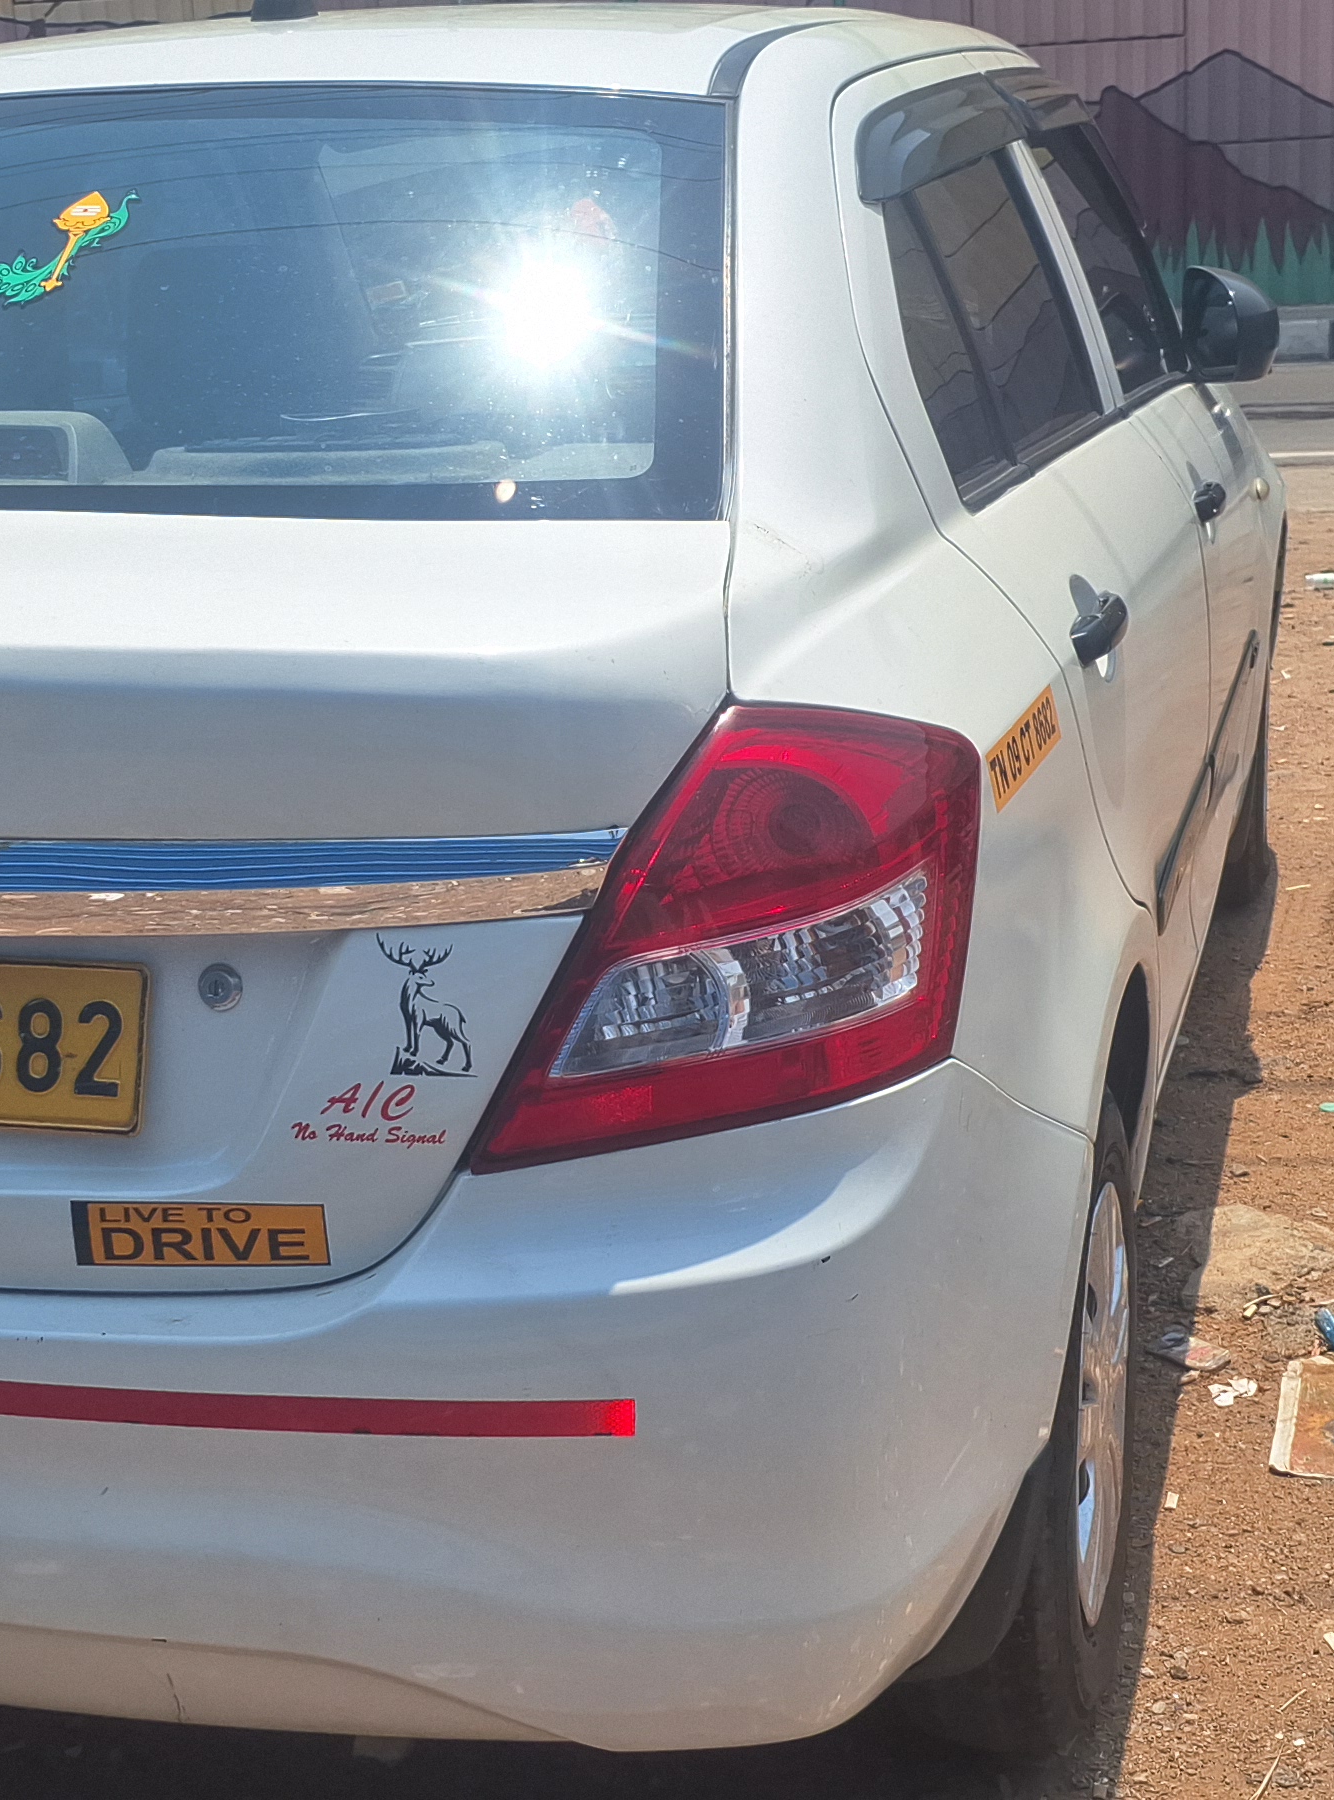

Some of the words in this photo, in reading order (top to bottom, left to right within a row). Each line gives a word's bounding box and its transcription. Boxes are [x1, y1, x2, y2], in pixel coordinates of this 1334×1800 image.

[990, 750, 1010, 799] TN
[1007, 735, 1022, 782] 09
[1020, 719, 1036, 766] CT
[1032, 696, 1057, 751] 8682
[320, 1080, 416, 1121] A/C
[291, 1121, 318, 1141] No
[325, 1123, 379, 1143] Hand
[385, 1125, 447, 1149] Signal
[99, 1206, 185, 1223] LIVE
[198, 1207, 252, 1224] TO
[101, 1227, 310, 1261] DRIVE
